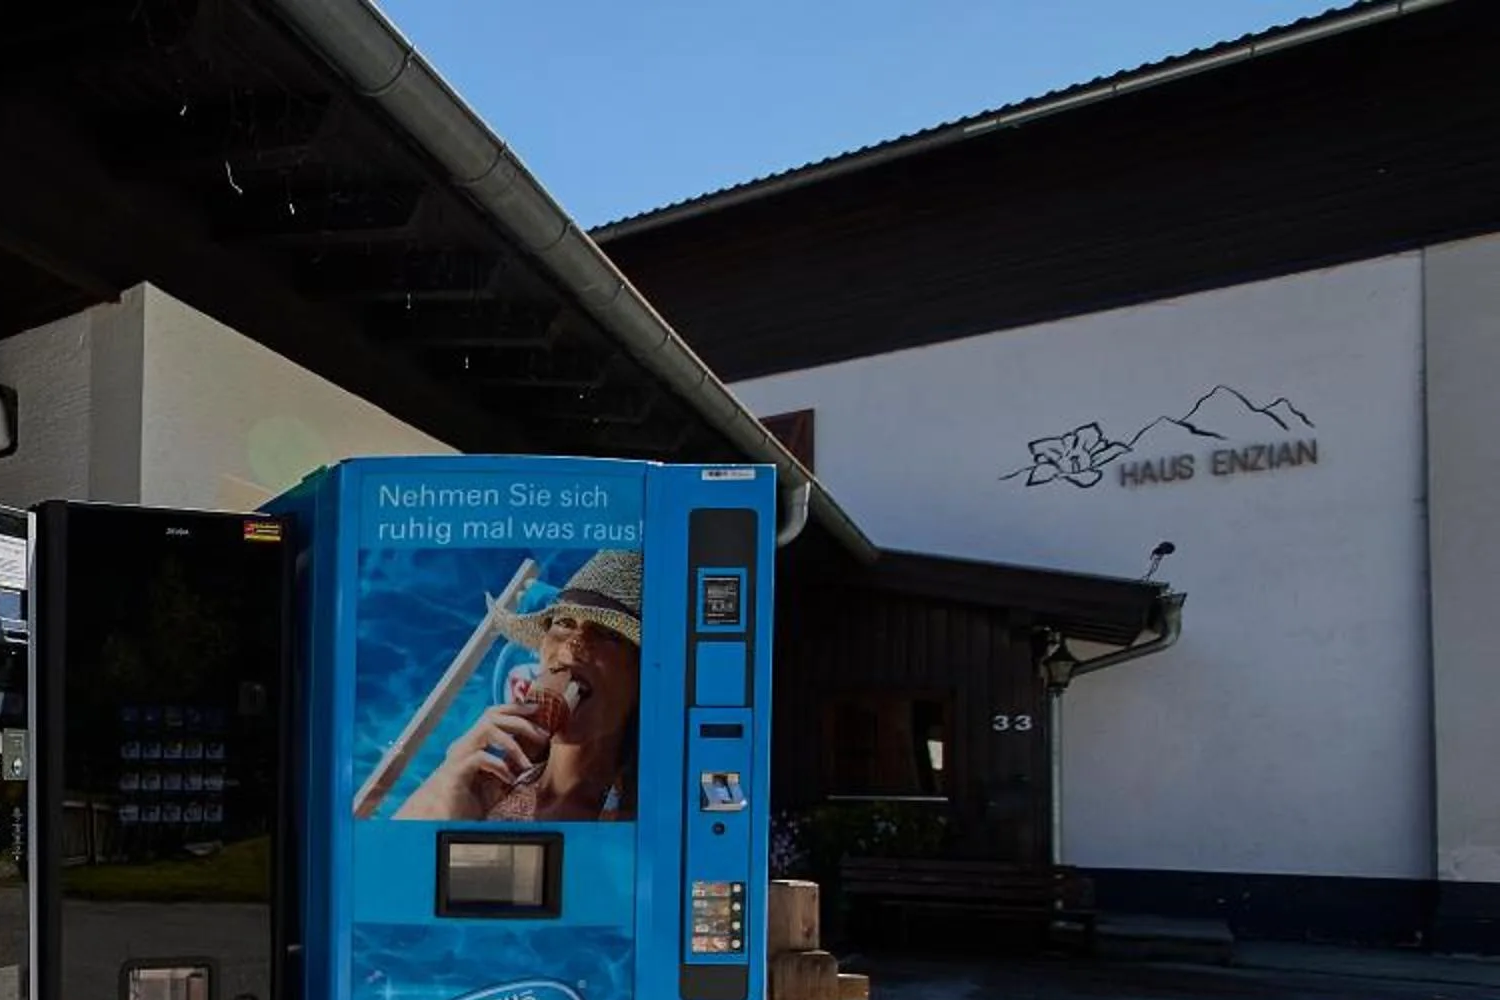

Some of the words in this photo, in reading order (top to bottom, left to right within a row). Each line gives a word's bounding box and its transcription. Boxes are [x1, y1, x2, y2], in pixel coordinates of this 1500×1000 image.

[1119, 454, 1195, 487] HAUS
[1211, 438, 1319, 477] ENZIAN
[379, 484, 499, 508] Nehmen
[509, 483, 551, 507] Sie
[559, 484, 608, 508] sich
[379, 517, 451, 545] ruhig
[462, 517, 513, 540] mal
[522, 522, 575, 541] was
[583, 519, 644, 543] raus!
[991, 714, 1033, 732] 33
